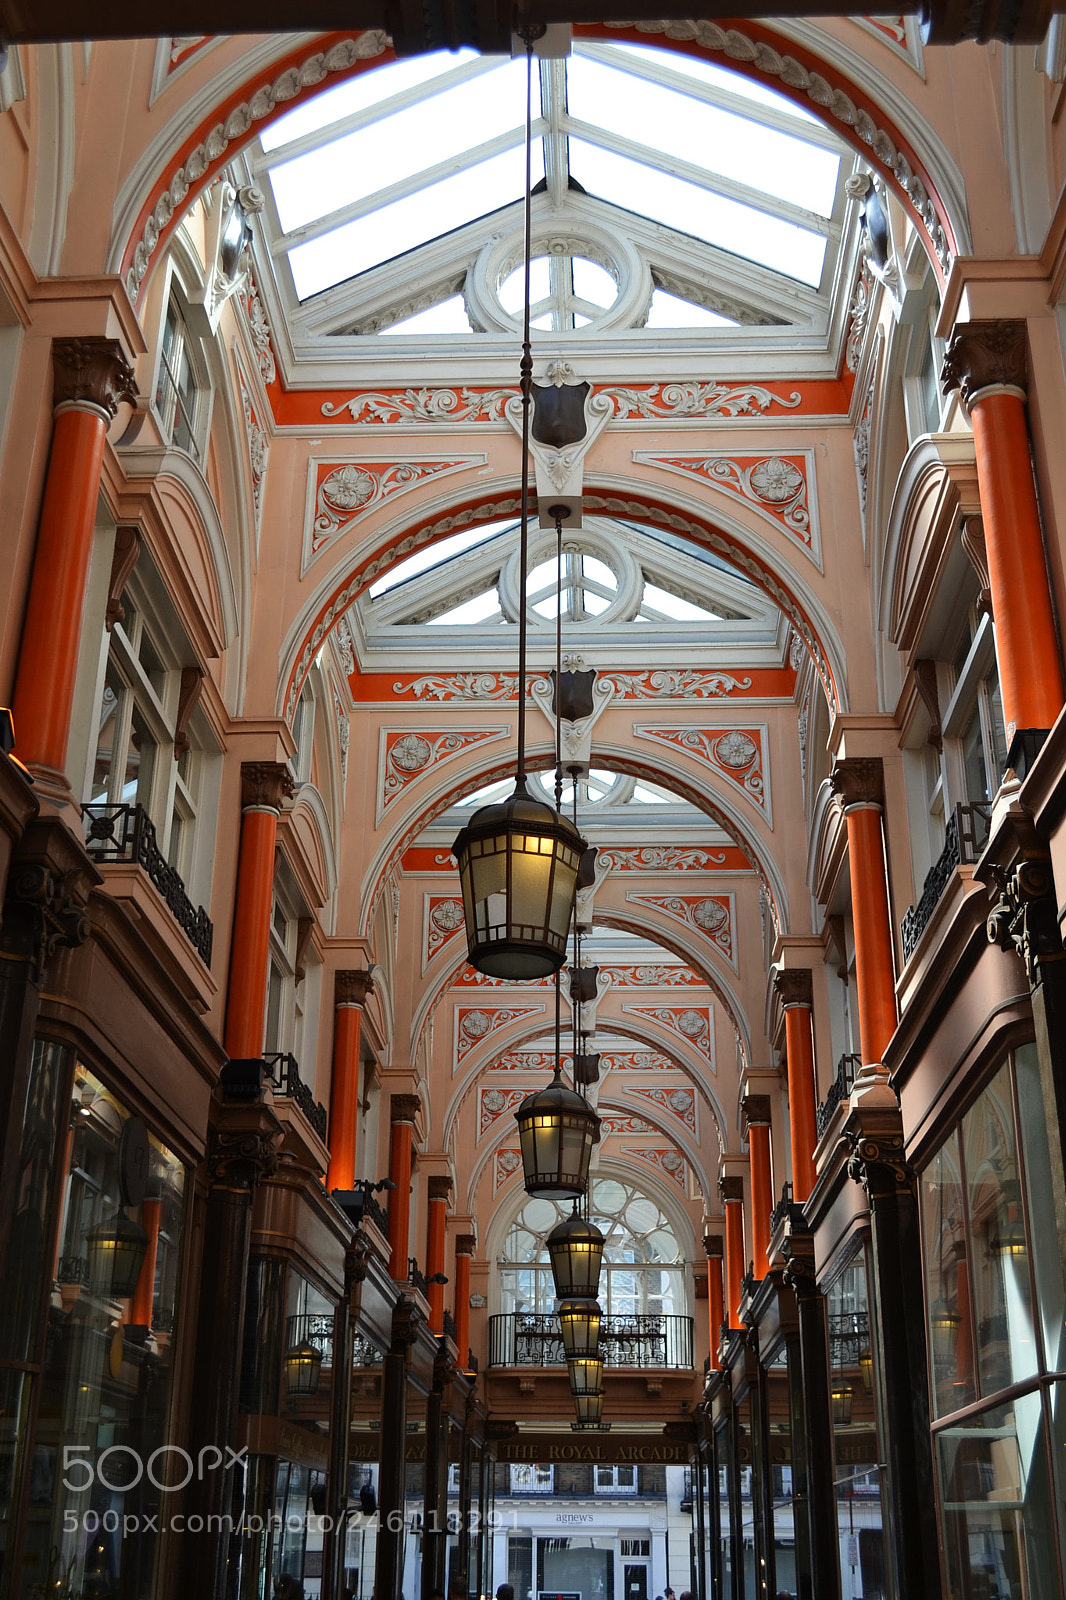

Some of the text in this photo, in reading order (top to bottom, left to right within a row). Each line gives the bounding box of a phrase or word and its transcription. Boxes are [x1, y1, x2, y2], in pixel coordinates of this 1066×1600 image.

[504, 1444, 685, 1461] THE ROYAL ARCADE
